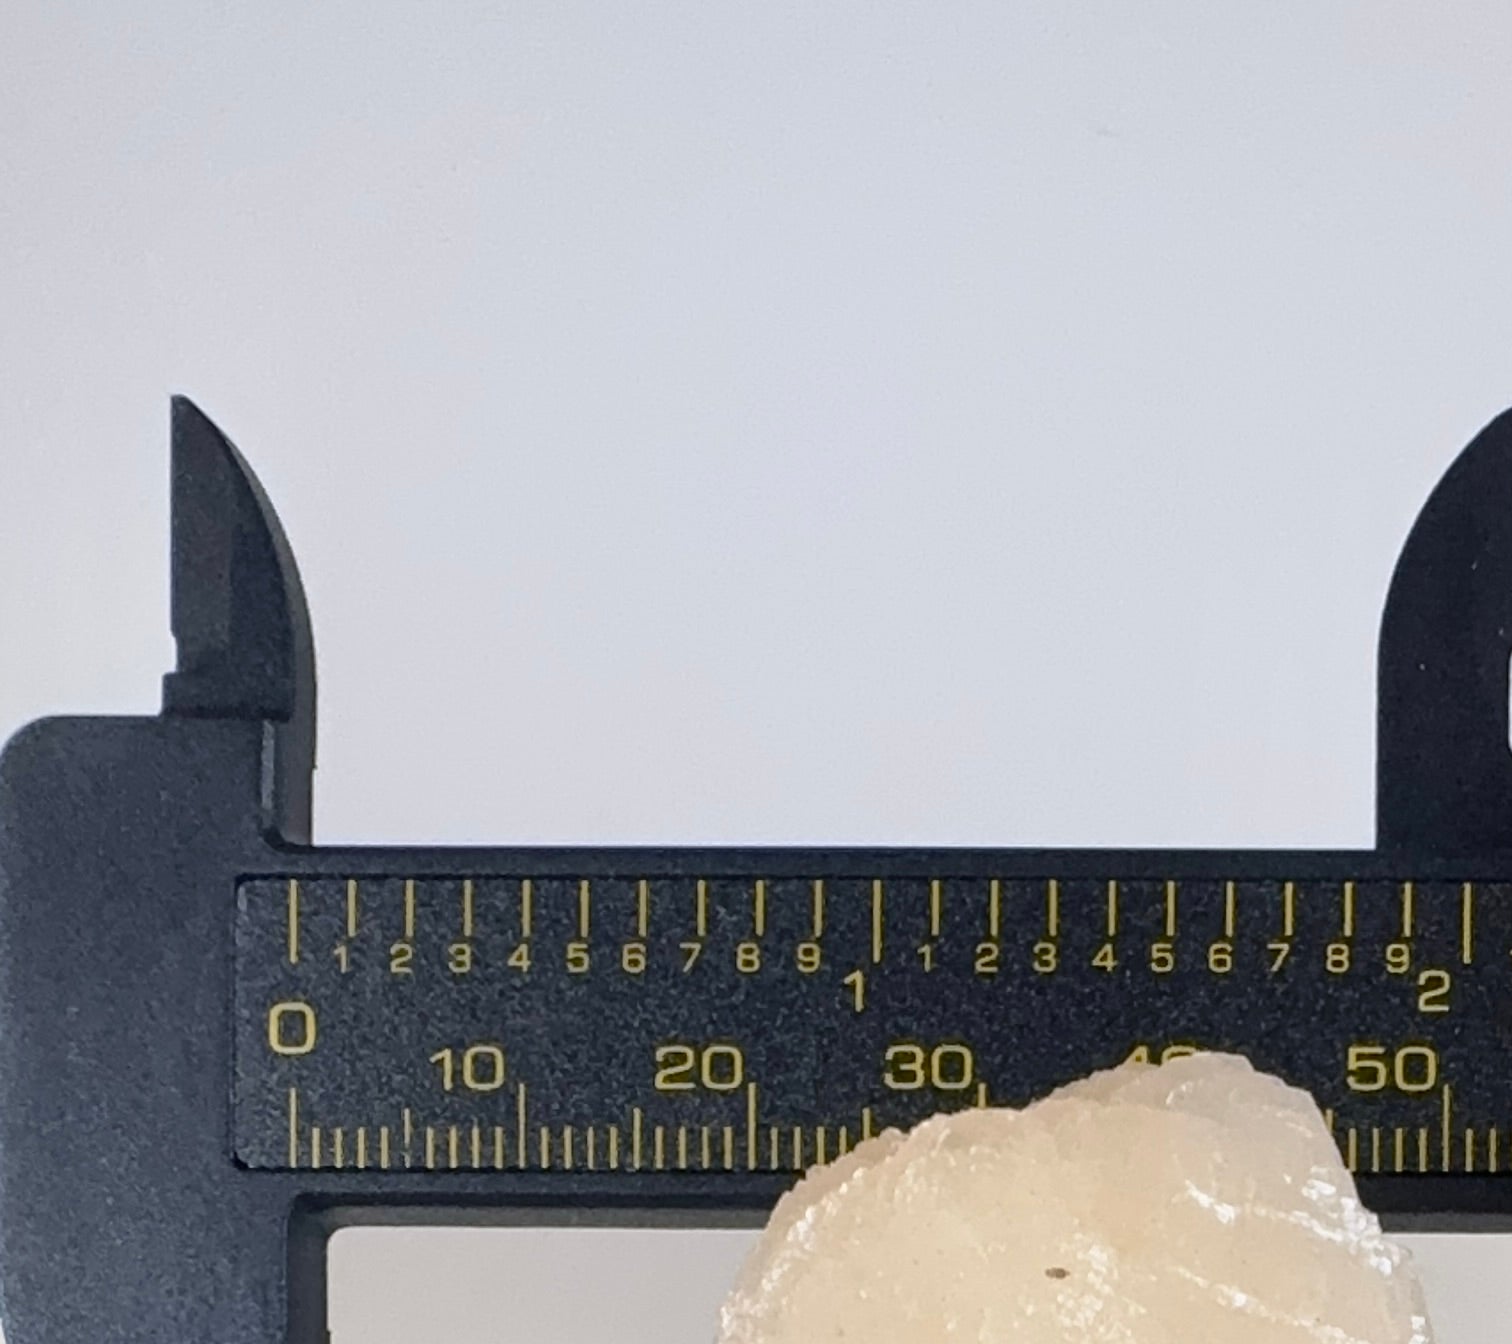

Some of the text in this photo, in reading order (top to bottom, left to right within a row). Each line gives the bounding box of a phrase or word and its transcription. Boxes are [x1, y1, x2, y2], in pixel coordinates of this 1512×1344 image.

[332, 943, 348, 974] 1
[389, 943, 413, 974] 2
[447, 943, 472, 974] 3
[506, 943, 532, 973] 4
[566, 942, 590, 973] 5
[622, 942, 647, 974] 6
[679, 942, 702, 973] 7
[736, 942, 761, 973] 8
[796, 942, 821, 973] 9
[917, 943, 932, 973] 1
[974, 942, 999, 973] 2
[1032, 941, 1057, 973] 3
[1091, 943, 1118, 972] 4
[1150, 942, 1174, 973] 5
[1208, 942, 1233, 973] 6
[1266, 942, 1290, 972] 7
[1326, 943, 1350, 973] 8
[1385, 943, 1410, 974] 9
[843, 969, 1451, 1013] 1 2
[268, 1001, 316, 1055] 0
[429, 1045, 505, 1091] 10
[654, 1045, 743, 1091] 20
[883, 1043, 973, 1090] 30
[1346, 1045, 1437, 1092] 50
